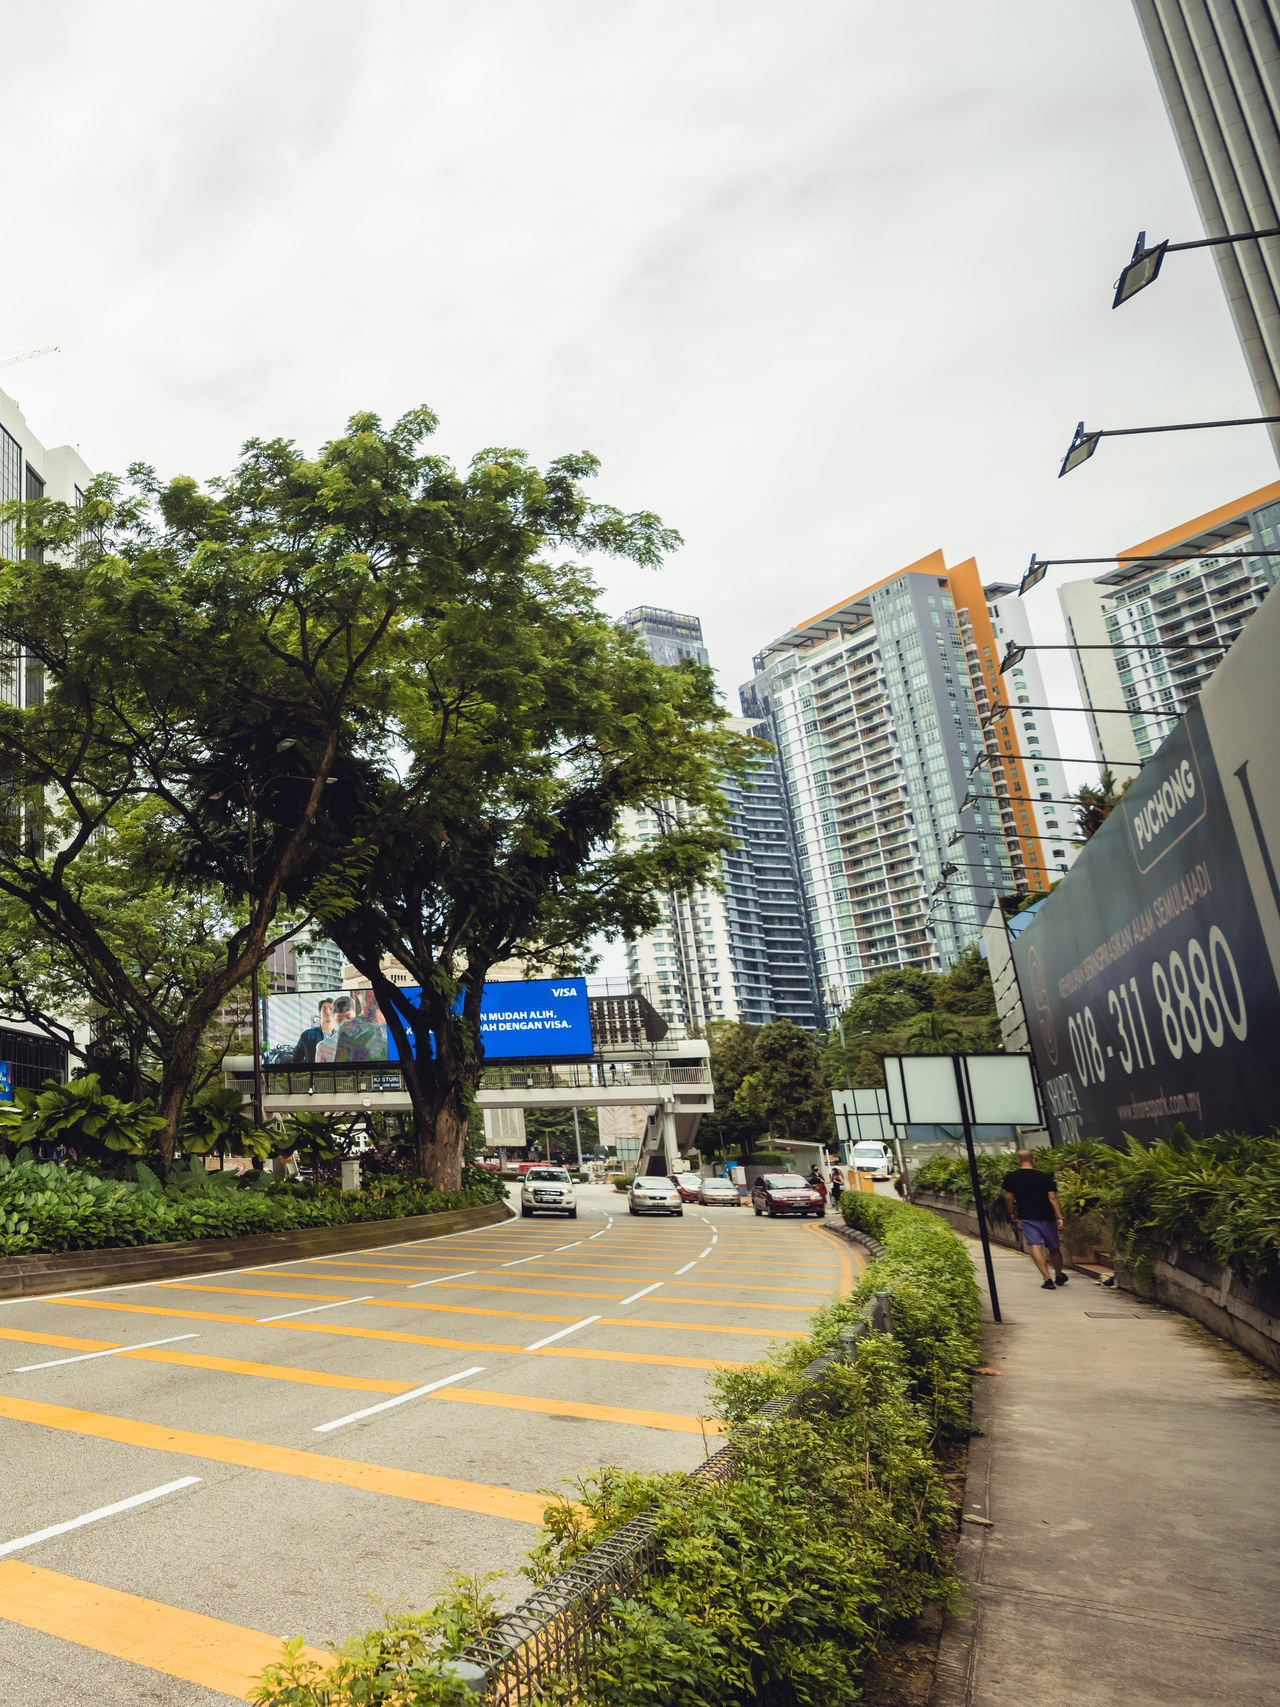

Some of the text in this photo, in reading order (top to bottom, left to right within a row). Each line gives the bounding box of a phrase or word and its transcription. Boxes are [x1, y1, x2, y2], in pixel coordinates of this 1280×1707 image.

[1133, 759, 1195, 851] PUCHONG
[1131, 906, 1157, 946] ALAM
[1152, 860, 1212, 929] SEMULAJADI
[550, 987, 577, 998] VISA
[1068, 1005, 1106, 1088] 018
[1108, 976, 1156, 1075] 311
[1151, 924, 1248, 1060] 8880
[489, 1011, 528, 1021] MUDAH
[529, 1010, 557, 1020] ALIH,
[498, 1021, 542, 1031] DENGAN
[543, 1019, 572, 1030] VISA.
[1046, 1072, 1081, 1117] SHOREA
